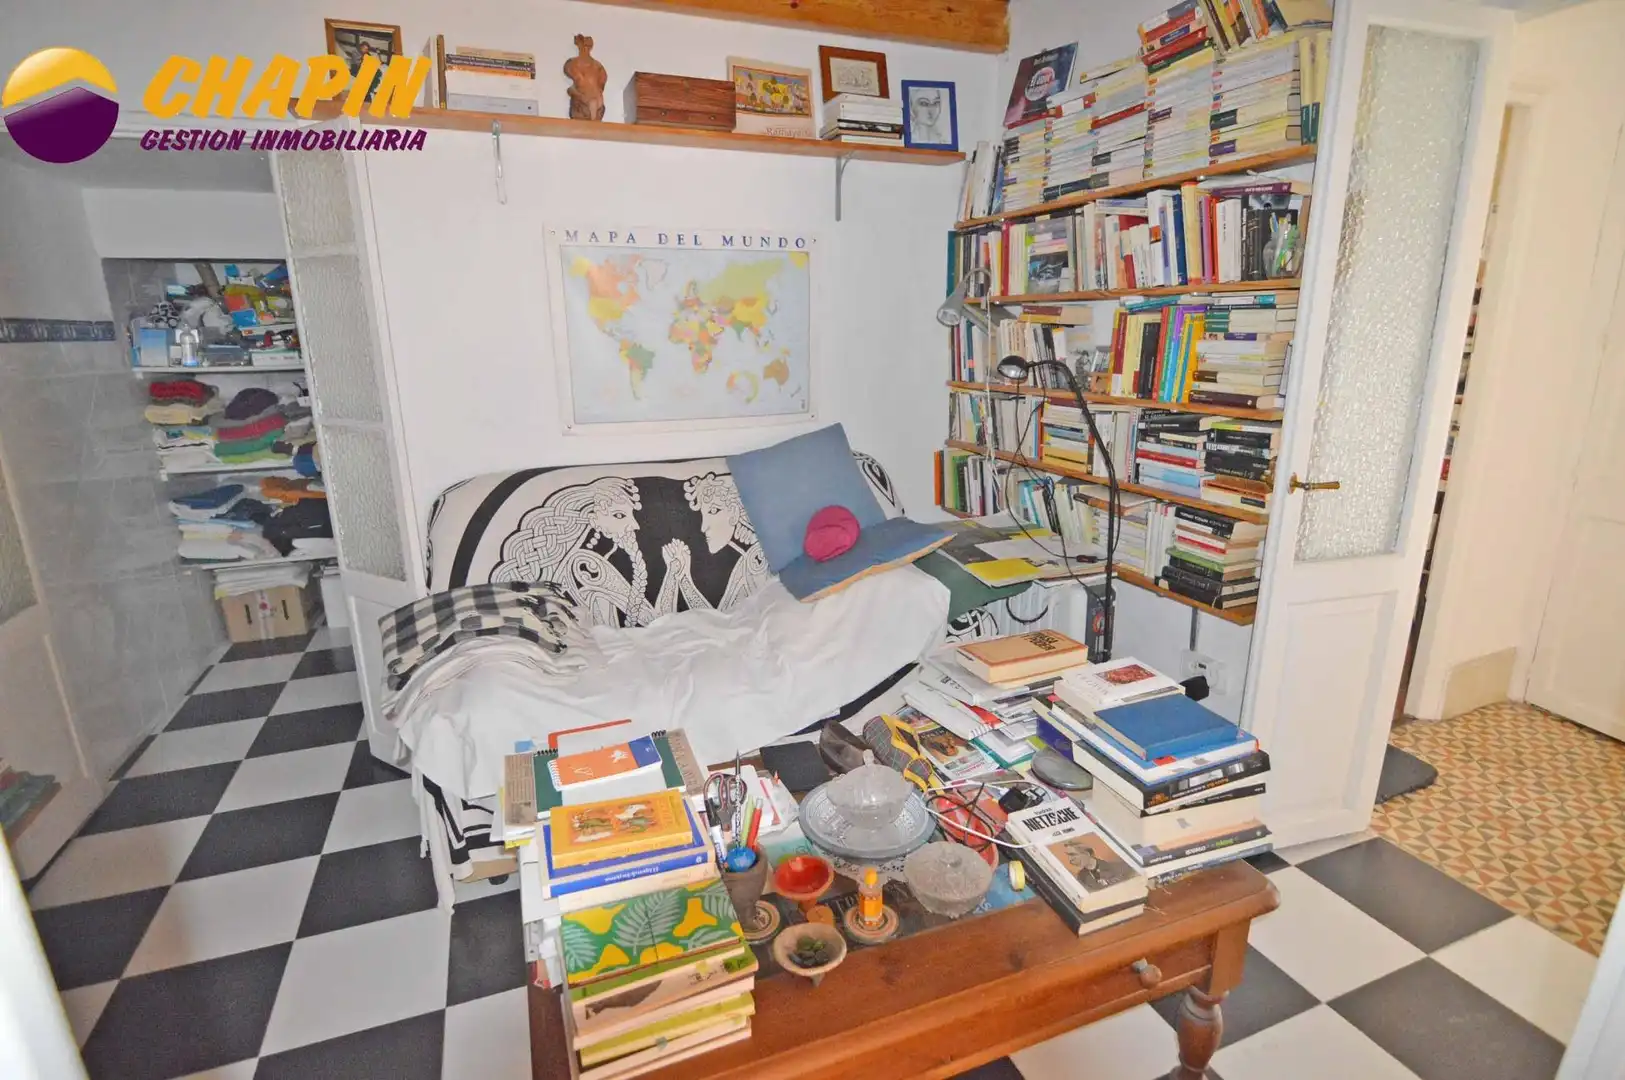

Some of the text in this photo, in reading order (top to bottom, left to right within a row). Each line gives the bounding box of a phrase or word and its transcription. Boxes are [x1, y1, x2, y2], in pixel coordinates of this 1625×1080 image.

[565, 229, 806, 249] MAPA DEL MUNDO
[1021, 807, 1080, 832] NIETZSCHE
